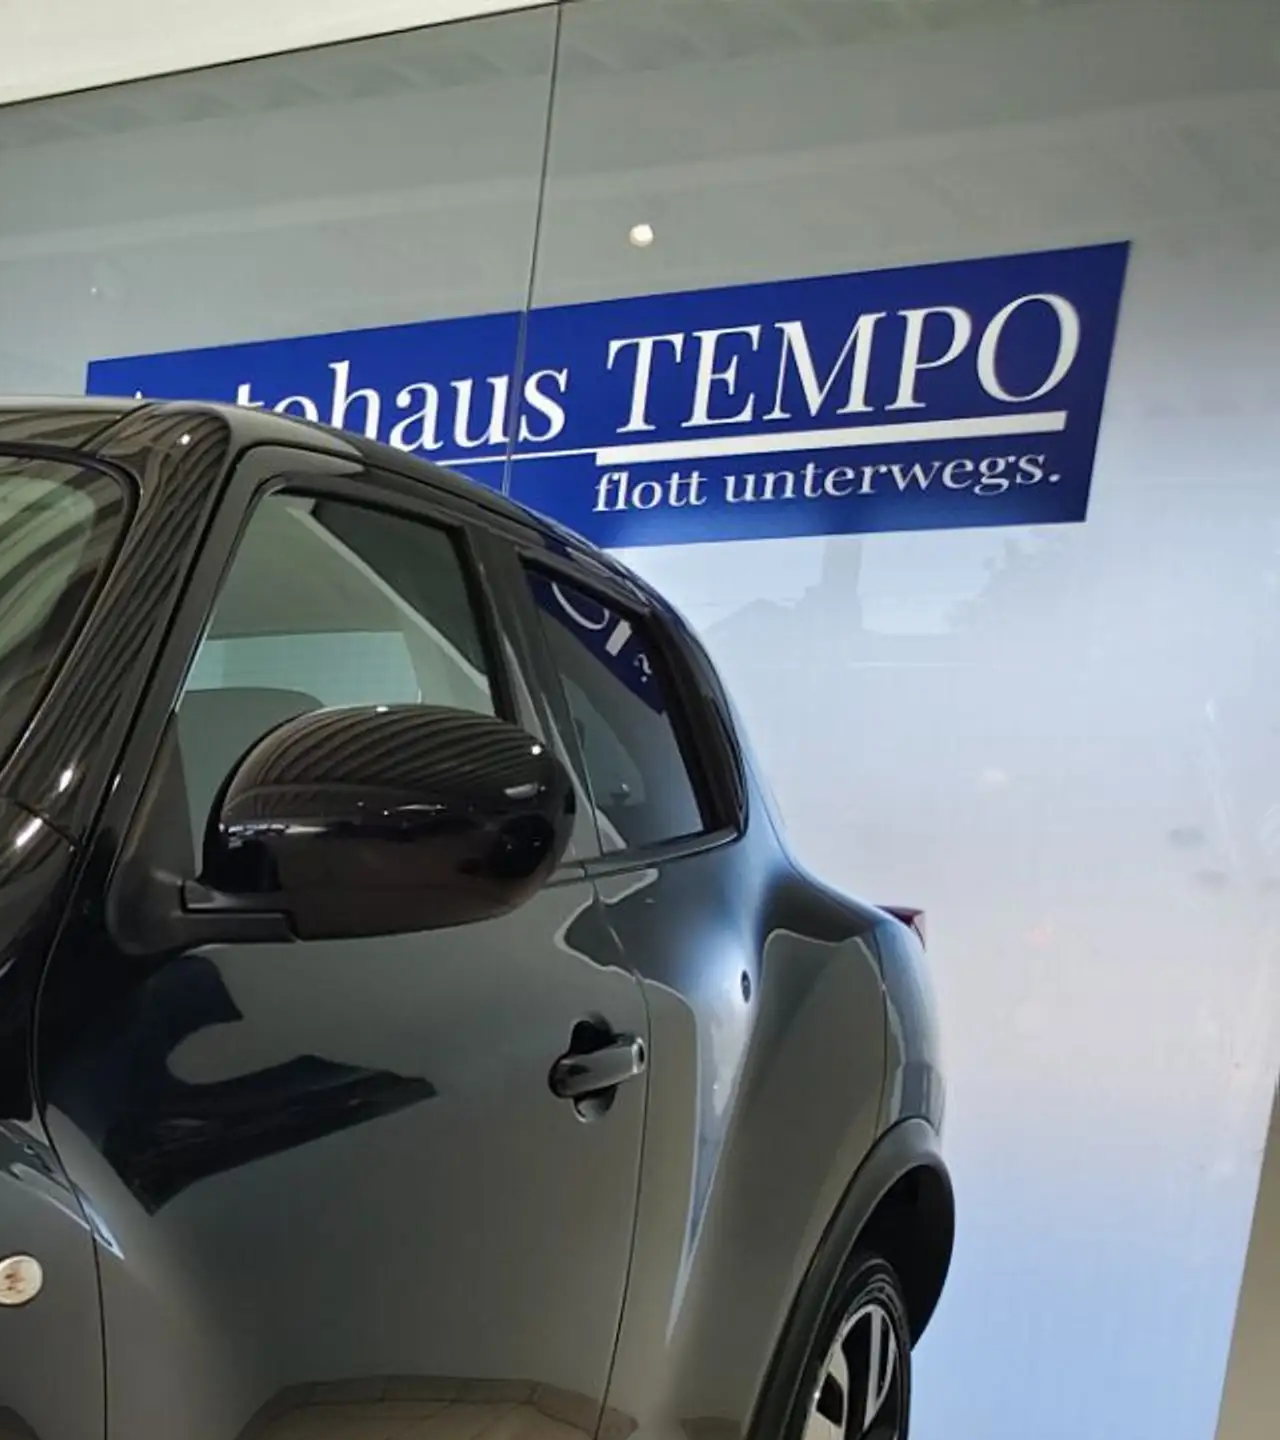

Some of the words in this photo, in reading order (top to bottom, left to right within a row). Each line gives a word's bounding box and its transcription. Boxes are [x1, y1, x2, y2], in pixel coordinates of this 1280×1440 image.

[134, 360, 569, 451] haus
[605, 293, 1081, 433] TEMPO
[591, 468, 708, 512] flott
[724, 451, 1061, 501] unterwegs.
